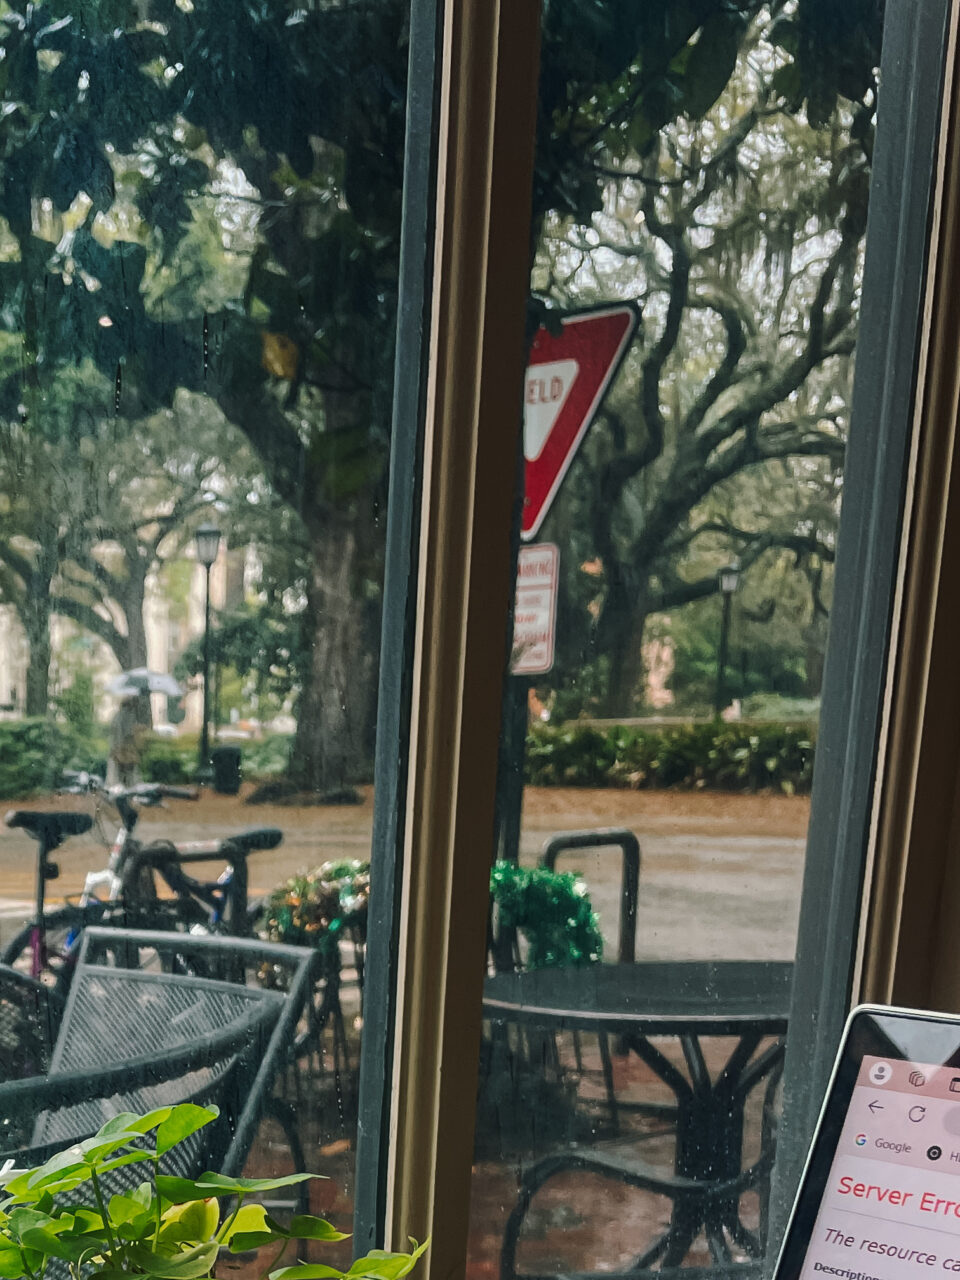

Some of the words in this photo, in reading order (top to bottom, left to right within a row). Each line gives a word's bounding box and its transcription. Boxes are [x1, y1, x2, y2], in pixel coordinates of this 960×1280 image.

[527, 377, 564, 404] ELD
[874, 1137, 913, 1154] Google
[837, 1176, 913, 1207] Server
[824, 1228, 855, 1247] The
[859, 1239, 937, 1266] resource
